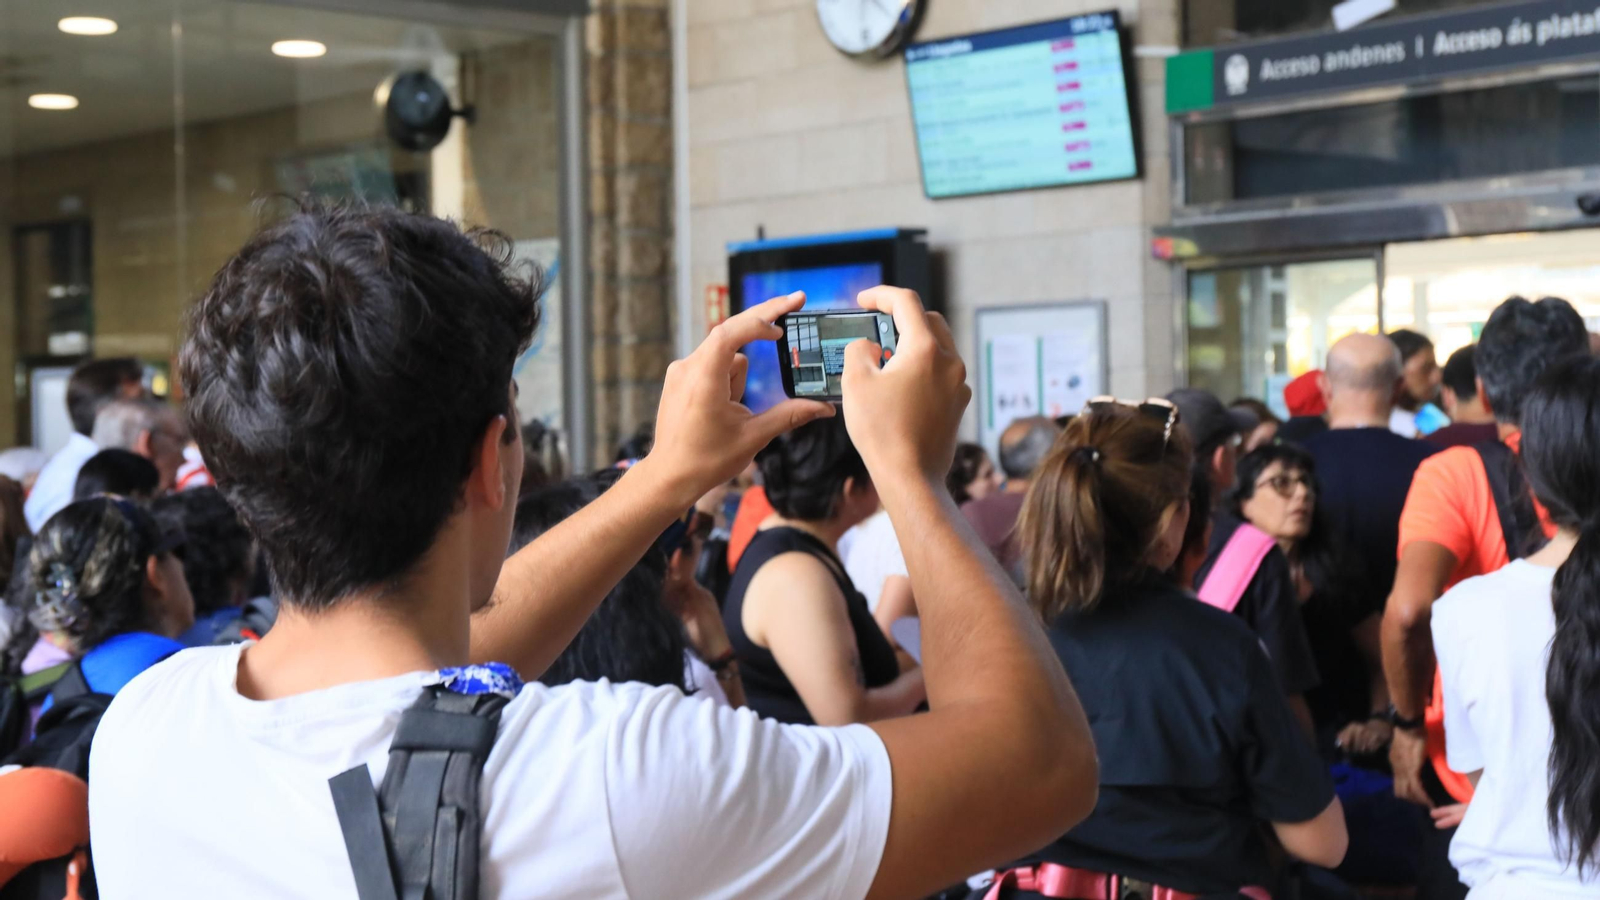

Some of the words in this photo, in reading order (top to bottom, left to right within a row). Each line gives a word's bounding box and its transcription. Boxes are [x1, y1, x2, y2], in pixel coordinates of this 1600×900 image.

[1259, 54, 1321, 81] Acceso
[1323, 41, 1406, 72] andenes
[1433, 27, 1502, 56] Acceso
